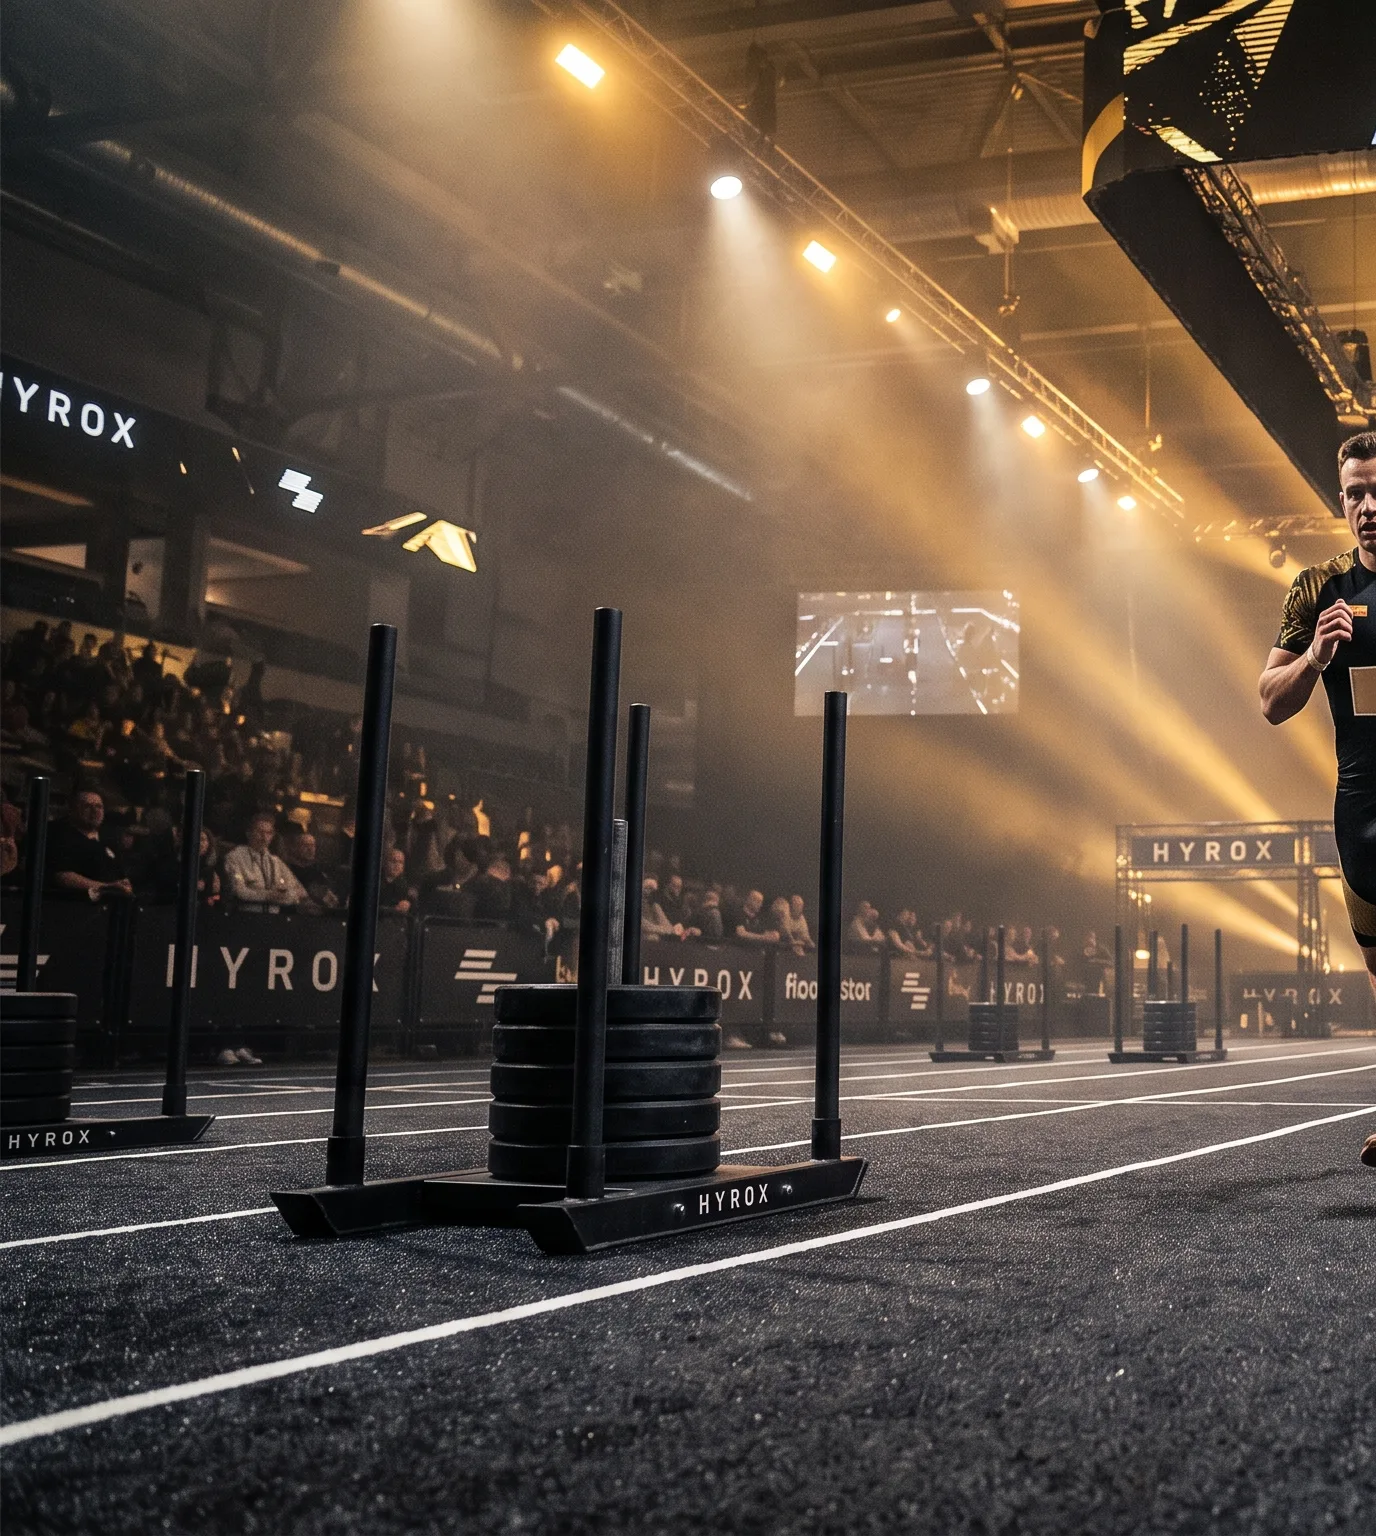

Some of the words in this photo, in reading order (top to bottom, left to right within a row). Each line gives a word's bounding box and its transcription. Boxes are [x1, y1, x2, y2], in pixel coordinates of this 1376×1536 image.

[0, 372, 136, 449] YROX
[1153, 840, 1272, 863] HYROX
[8, 1129, 90, 1149] HYROX
[699, 1183, 768, 1214] HYROX
